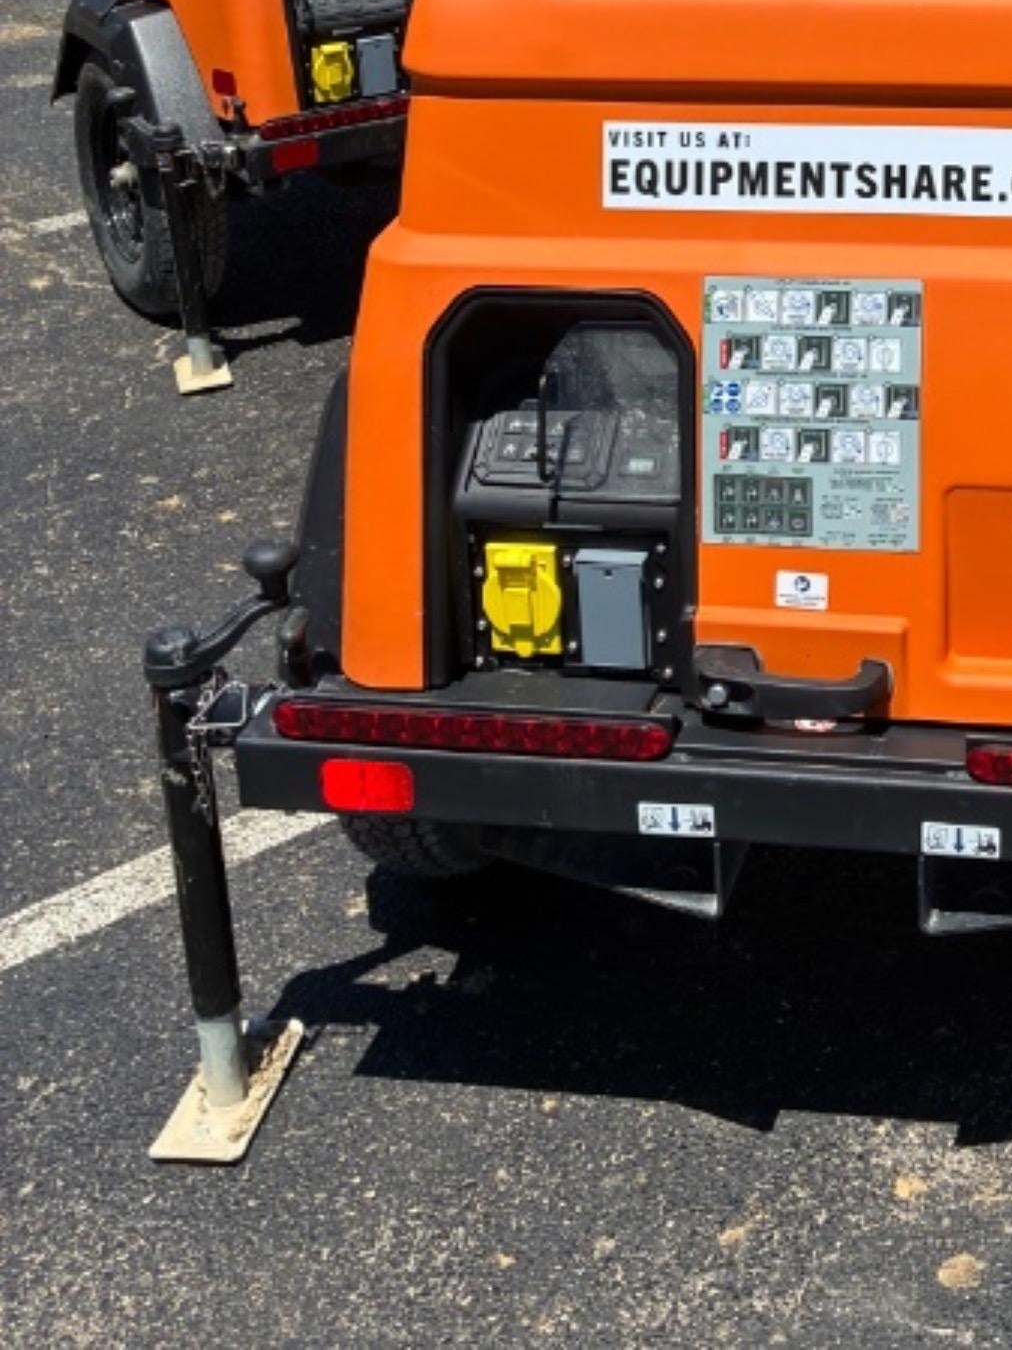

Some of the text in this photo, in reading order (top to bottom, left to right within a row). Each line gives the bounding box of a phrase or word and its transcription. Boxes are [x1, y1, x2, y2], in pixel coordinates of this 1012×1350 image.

[609, 131, 751, 149] VISIT US AT:
